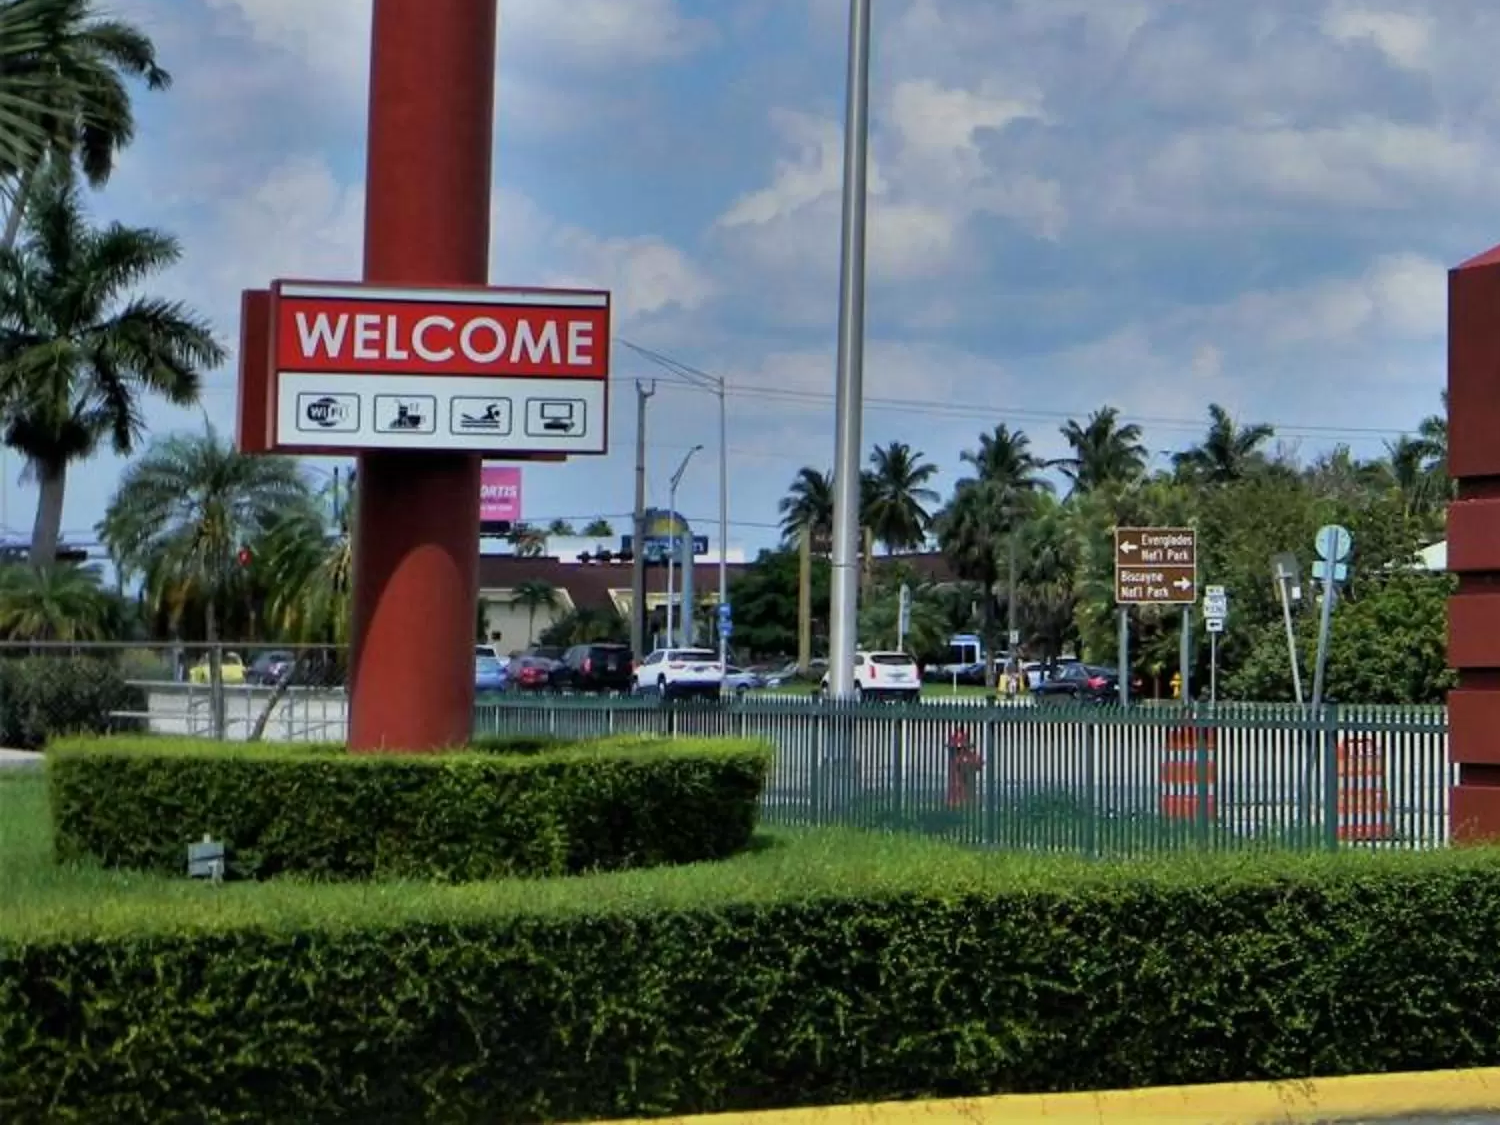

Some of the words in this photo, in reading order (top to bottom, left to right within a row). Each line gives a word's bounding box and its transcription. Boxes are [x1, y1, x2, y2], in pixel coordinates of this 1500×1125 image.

[295, 311, 594, 365] WELCOME
[1141, 533, 1193, 548] Everglades
[1167, 548, 1189, 561] Park
[1121, 570, 1164, 584] Biscayne
[1147, 586, 1169, 598] Park
